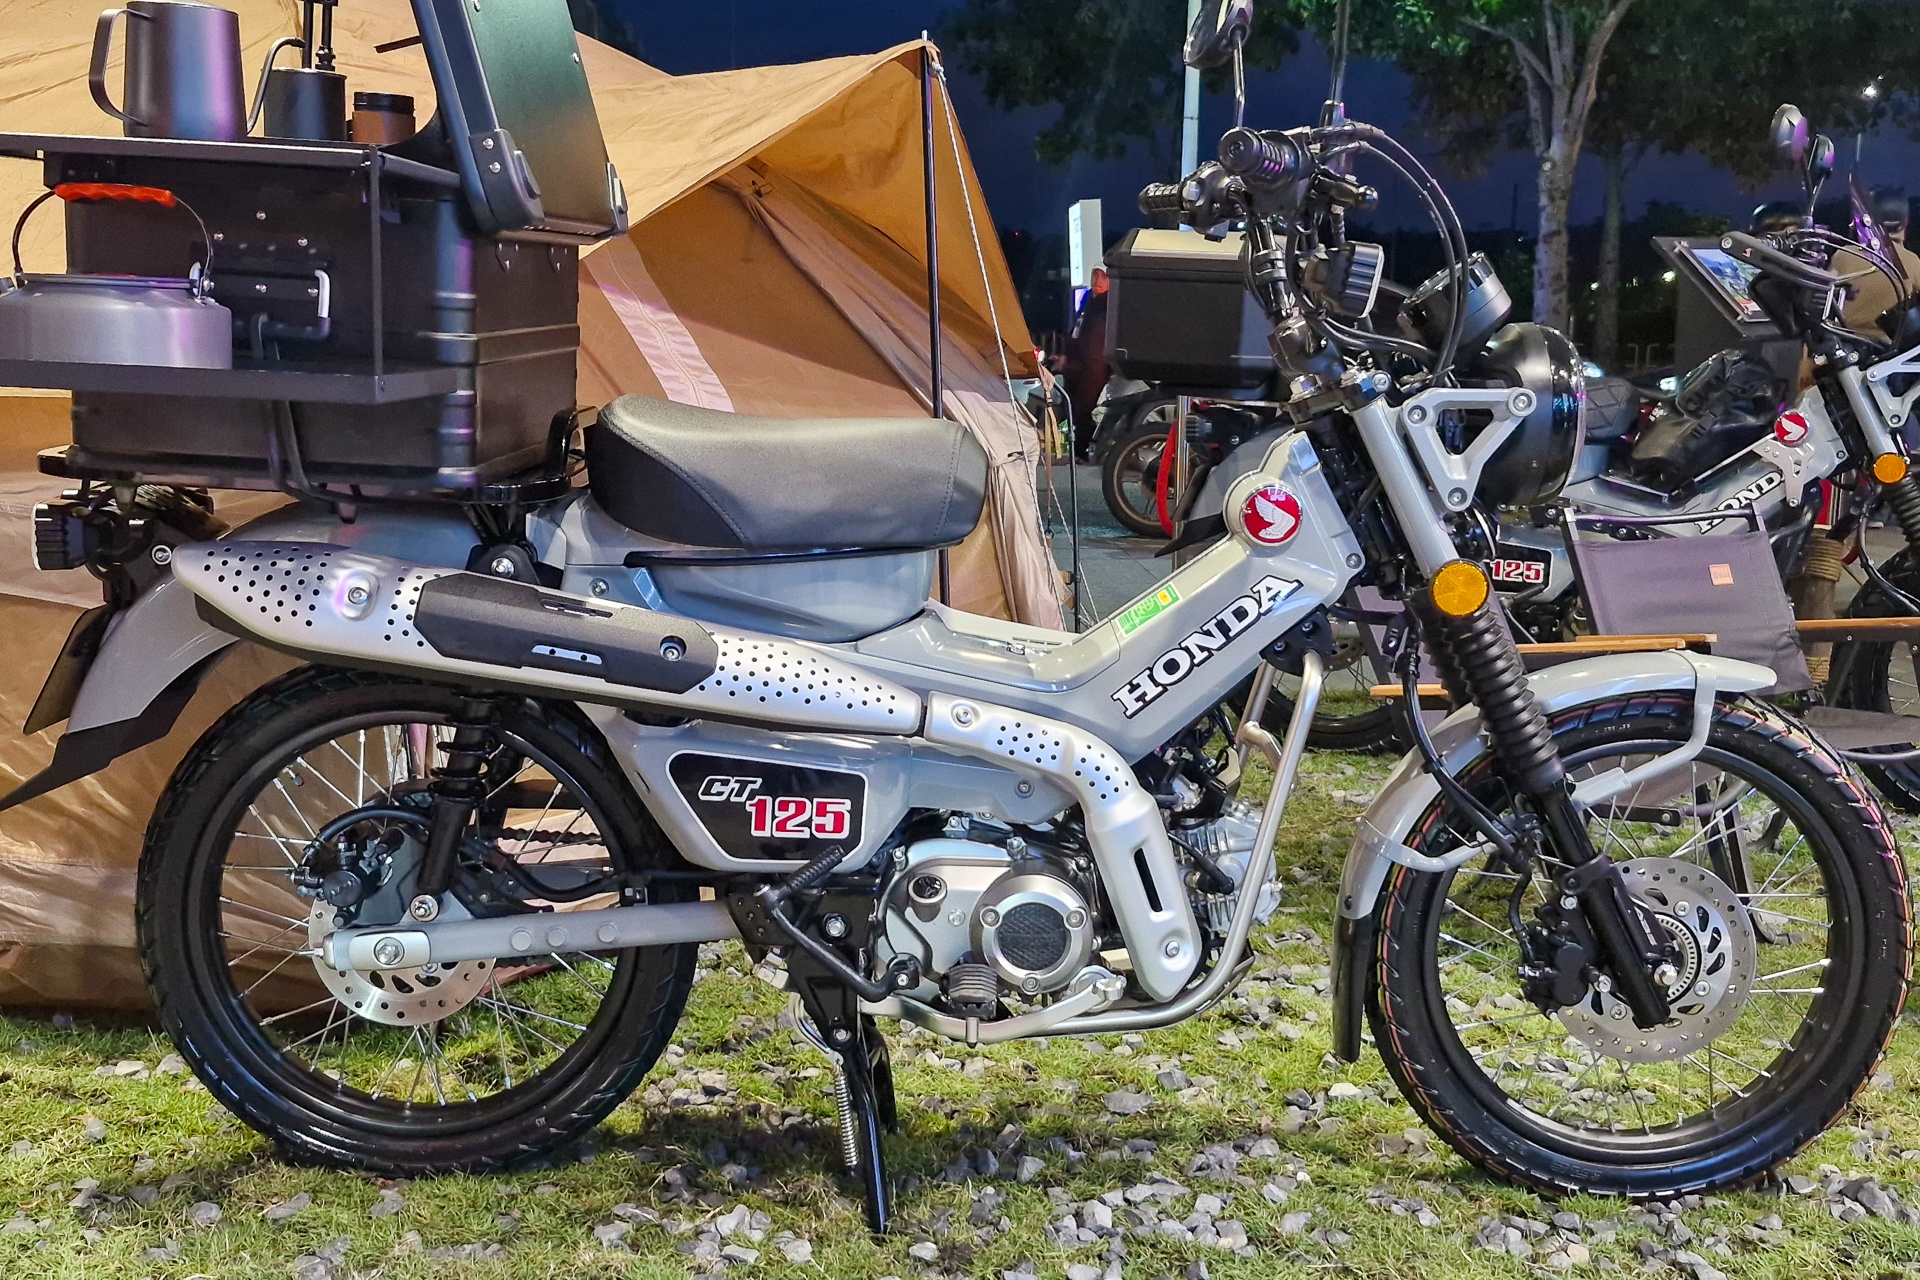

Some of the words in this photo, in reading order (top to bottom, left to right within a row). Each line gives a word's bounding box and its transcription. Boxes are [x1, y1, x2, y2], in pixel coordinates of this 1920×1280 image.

[1490, 559, 1545, 584] 125
[1111, 575, 1304, 719] HONDA
[698, 775, 762, 802] CT
[746, 796, 851, 839] 125
